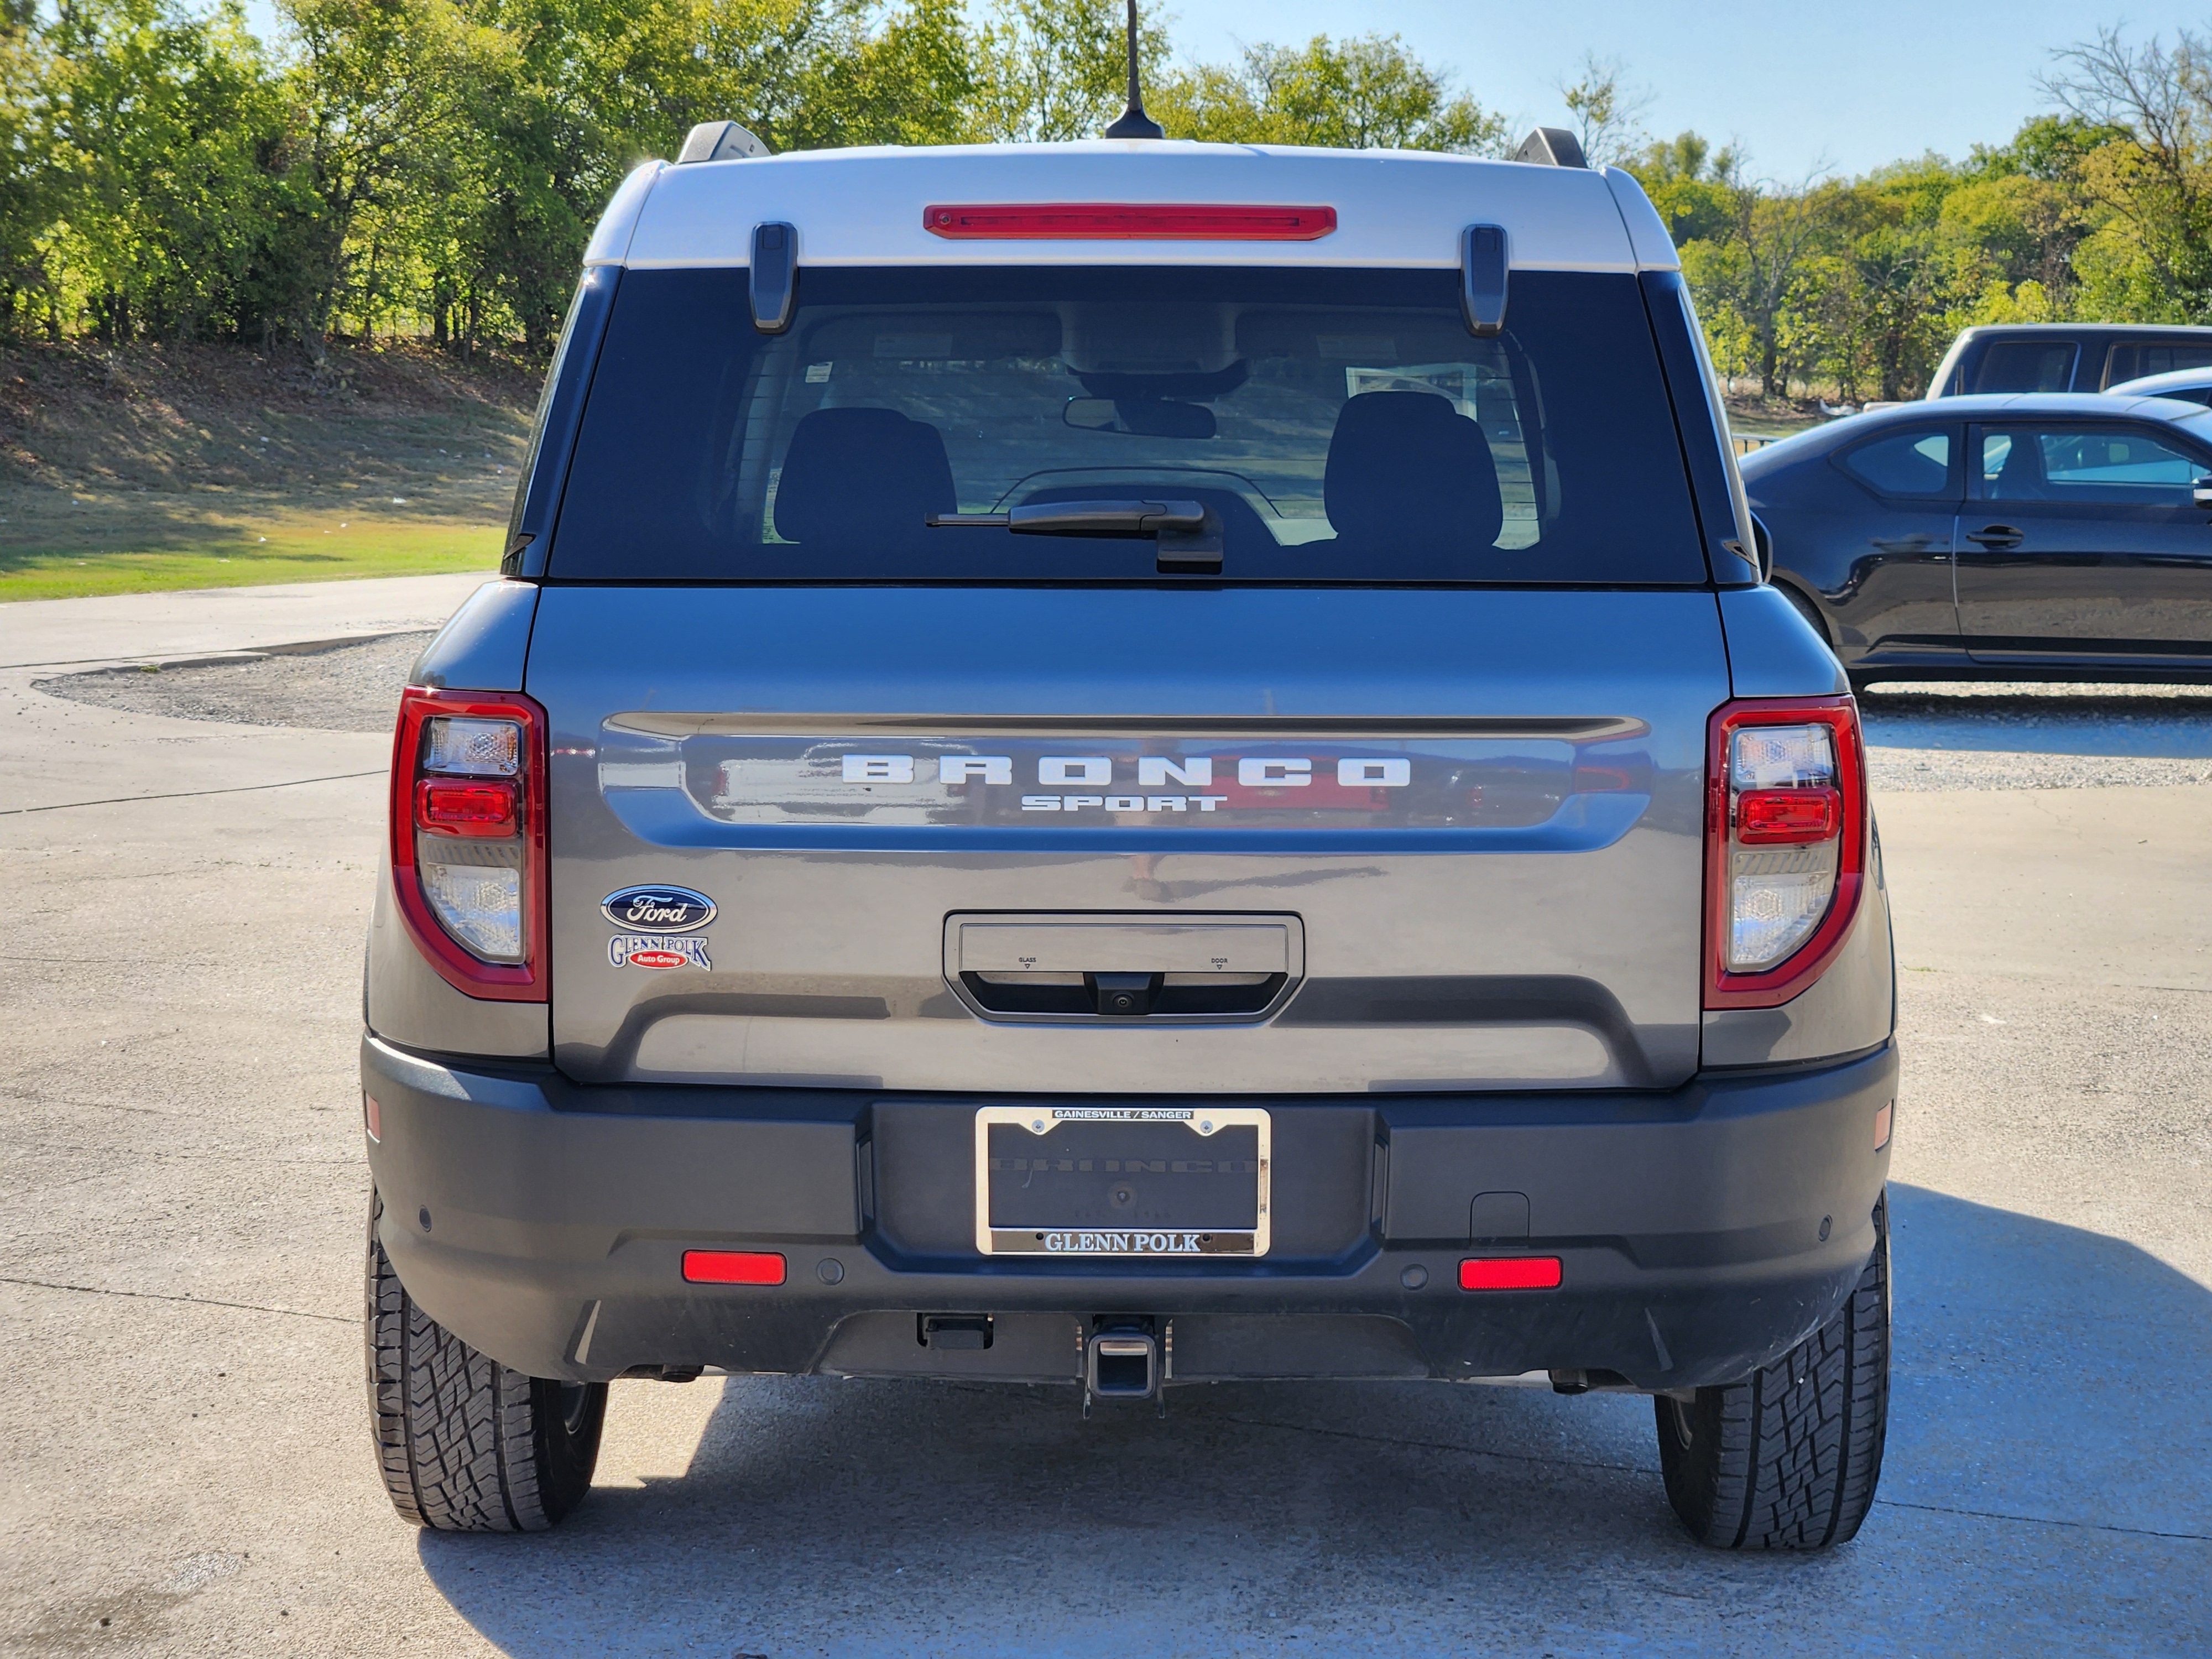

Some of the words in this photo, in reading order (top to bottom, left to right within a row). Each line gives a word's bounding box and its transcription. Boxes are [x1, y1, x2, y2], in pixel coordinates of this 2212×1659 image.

[842, 754, 1411, 786] BRONCO
[1021, 795, 1228, 811] SPORT
[627, 895, 687, 922] Ford
[610, 937, 662, 965] GLENN
[666, 939, 708, 968] POLK
[656, 955, 680, 966] Group
[1054, 1110, 1131, 1119] GAINESVILLE
[1045, 1233, 1130, 1251] GLENN
[1134, 1234, 1201, 1252] POLK
